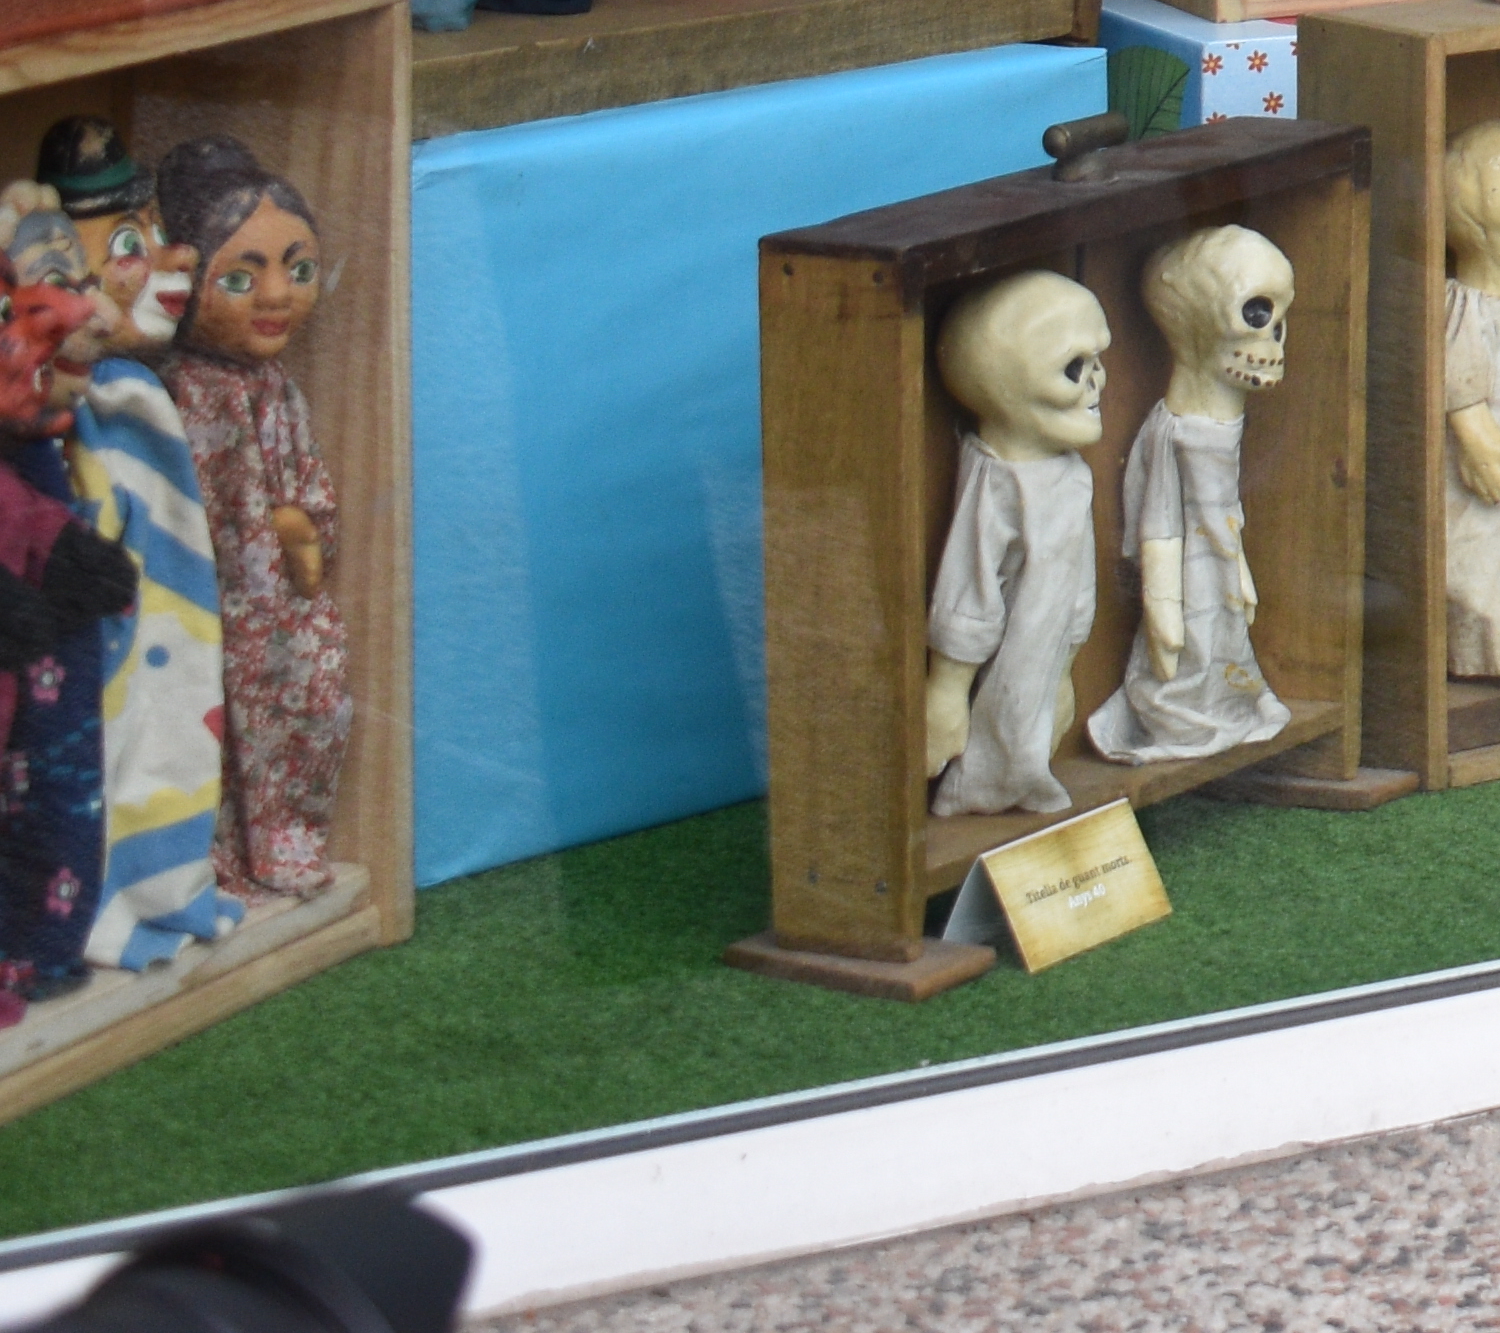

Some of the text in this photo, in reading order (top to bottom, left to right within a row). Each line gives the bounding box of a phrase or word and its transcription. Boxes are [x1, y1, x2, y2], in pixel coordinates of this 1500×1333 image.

[1059, 878, 1070, 891] de
[1072, 867, 1101, 890] guant
[1068, 890, 1092, 910] Anys
